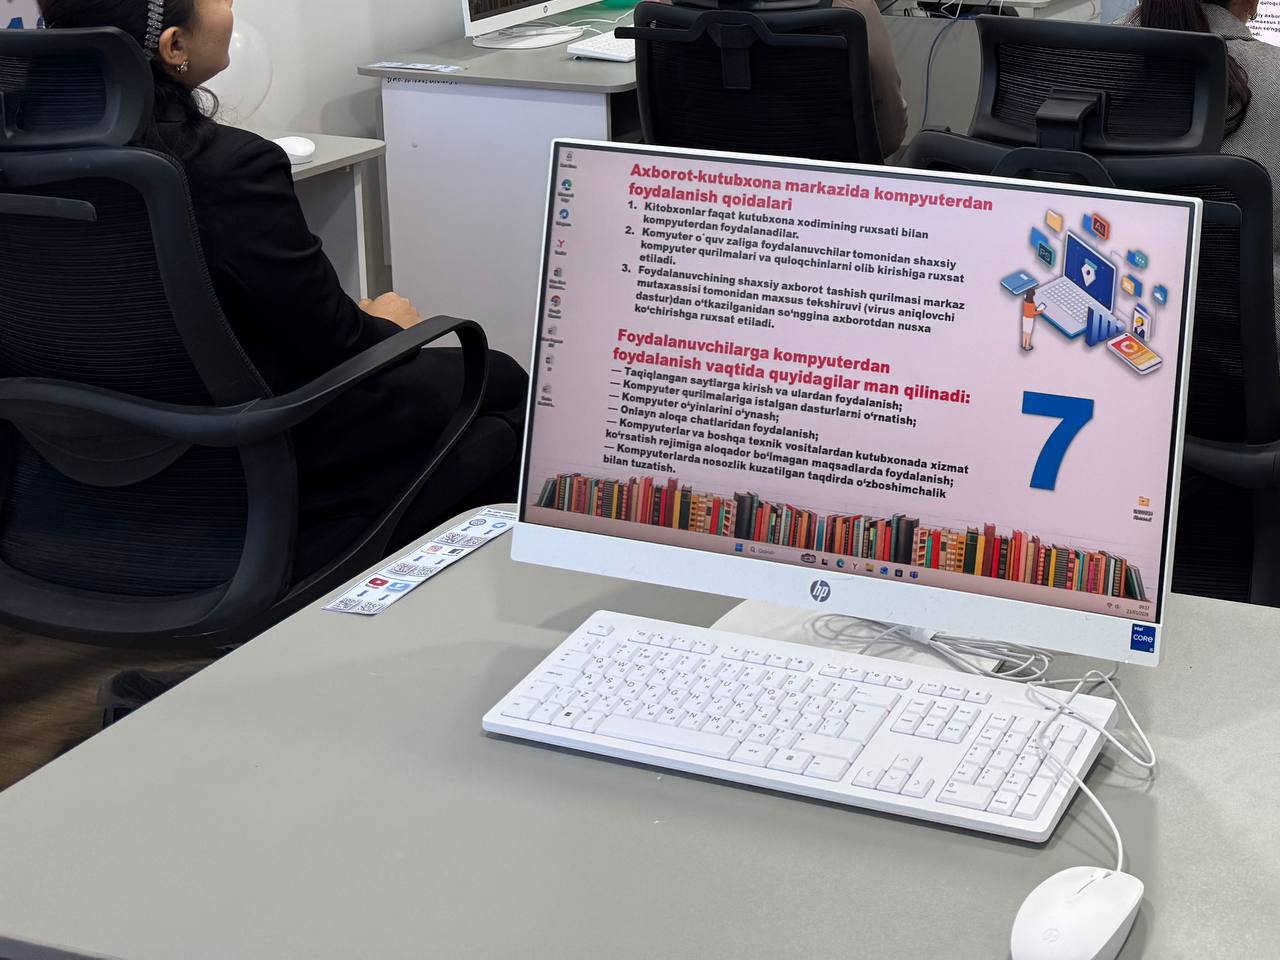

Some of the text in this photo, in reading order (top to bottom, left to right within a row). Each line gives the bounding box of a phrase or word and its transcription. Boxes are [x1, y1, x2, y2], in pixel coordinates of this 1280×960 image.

[628, 182, 792, 210] foydalanish qoidalari
[629, 163, 992, 210] Axborot-kutubxona markazida kompyuterdan
[627, 200, 928, 239] 1. Kitobxonlar faqat kutubxona xodimining ruxsati bilan
[642, 214, 799, 238] kompyuterdan foydalanadilar.
[624, 225, 634, 234] 2.
[641, 227, 693, 240] Komyuter
[726, 237, 758, 248] zaliga
[760, 239, 851, 257] foydalanuvchilar
[852, 249, 910, 264] tomonidan
[912, 255, 956, 270] shaxsiy
[639, 253, 675, 264] etiladi.
[640, 239, 964, 282] kompyuter qurilmalari va quloqchinlarni olib kirishiga ruxsat
[621, 263, 964, 309] 3. Foydalanuvchining shaxsiy axborot tashish qurilmasi markaz
[636, 279, 701, 293] mutaxassisi
[702, 285, 758, 300] tomonidan
[761, 293, 803, 304] maxsus
[806, 296, 861, 311] tekshiruvi
[897, 308, 955, 322] aniqlovchi
[700, 313, 734, 323] ruxsat
[737, 316, 774, 328] etiladi.
[832, 314, 894, 328] axborotdan
[897, 322, 931, 333] nusxa
[617, 328, 890, 374] Foydalanuvchilarga kompyuterdan
[612, 346, 970, 404] foydalanish vaqtida quyidagilar man qilinadi:
[624, 366, 902, 412] Taqiqlangan saytlarga kirish va ulardan foydalanish;
[621, 391, 678, 407] Kompyuter
[622, 379, 680, 395] Kompyuter
[681, 389, 752, 405] qurilmalariga
[754, 396, 798, 410] istalgan
[800, 402, 861, 419] dasturlarni
[620, 404, 818, 442] Onlayn aloqa chatlaridan foydalanish;
[1020, 391, 1095, 492] 7
[602, 453, 675, 473] bilan tuzatish.
[616, 442, 700, 464] Kompyuterlarda
[702, 457, 746, 470] nosozlik
[748, 461, 804, 478] kuzatilgan
[807, 470, 853, 485] taqdirda
[619, 417, 968, 474] Kompyuterlar va boshqa texnik vositalardan kutubxonada xizmat
[658, 437, 701, 451] rejimiga
[703, 443, 751, 457] aloqador
[811, 459, 883, 476] maqsadlarda
[885, 467, 953, 487] foydalanish;
[811, 579, 830, 602] hp
